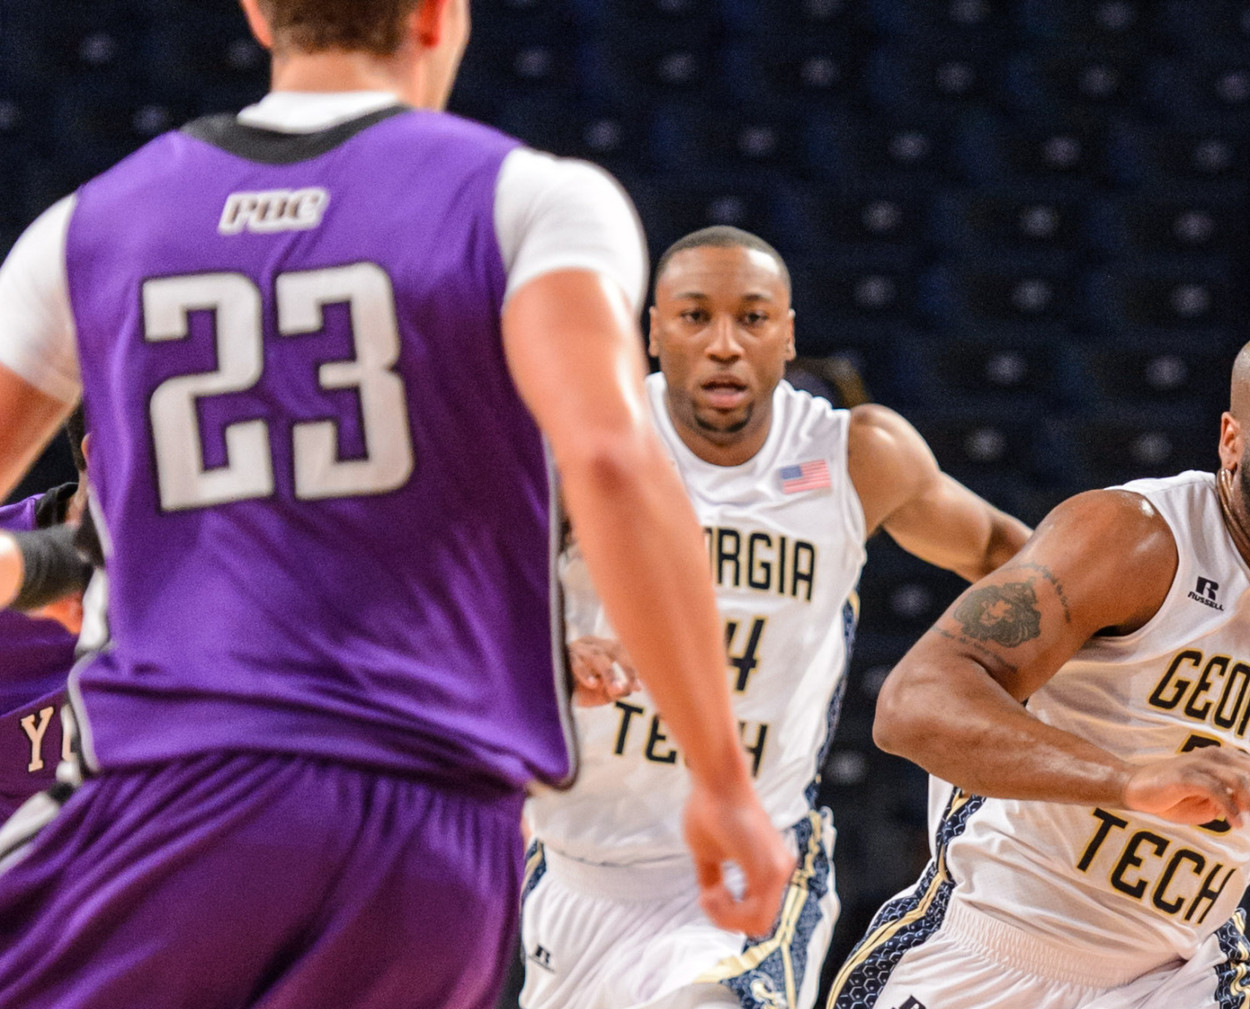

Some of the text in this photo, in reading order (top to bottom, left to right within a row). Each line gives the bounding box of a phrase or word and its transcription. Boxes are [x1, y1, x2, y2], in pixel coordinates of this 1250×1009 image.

[142, 261, 415, 513] 23
[702, 525, 816, 602] RGIA
[1187, 590, 1224, 611] RUSSELL
[725, 617, 767, 693] 4
[612, 700, 769, 779] TEH
[1076, 807, 1238, 924] TECH
